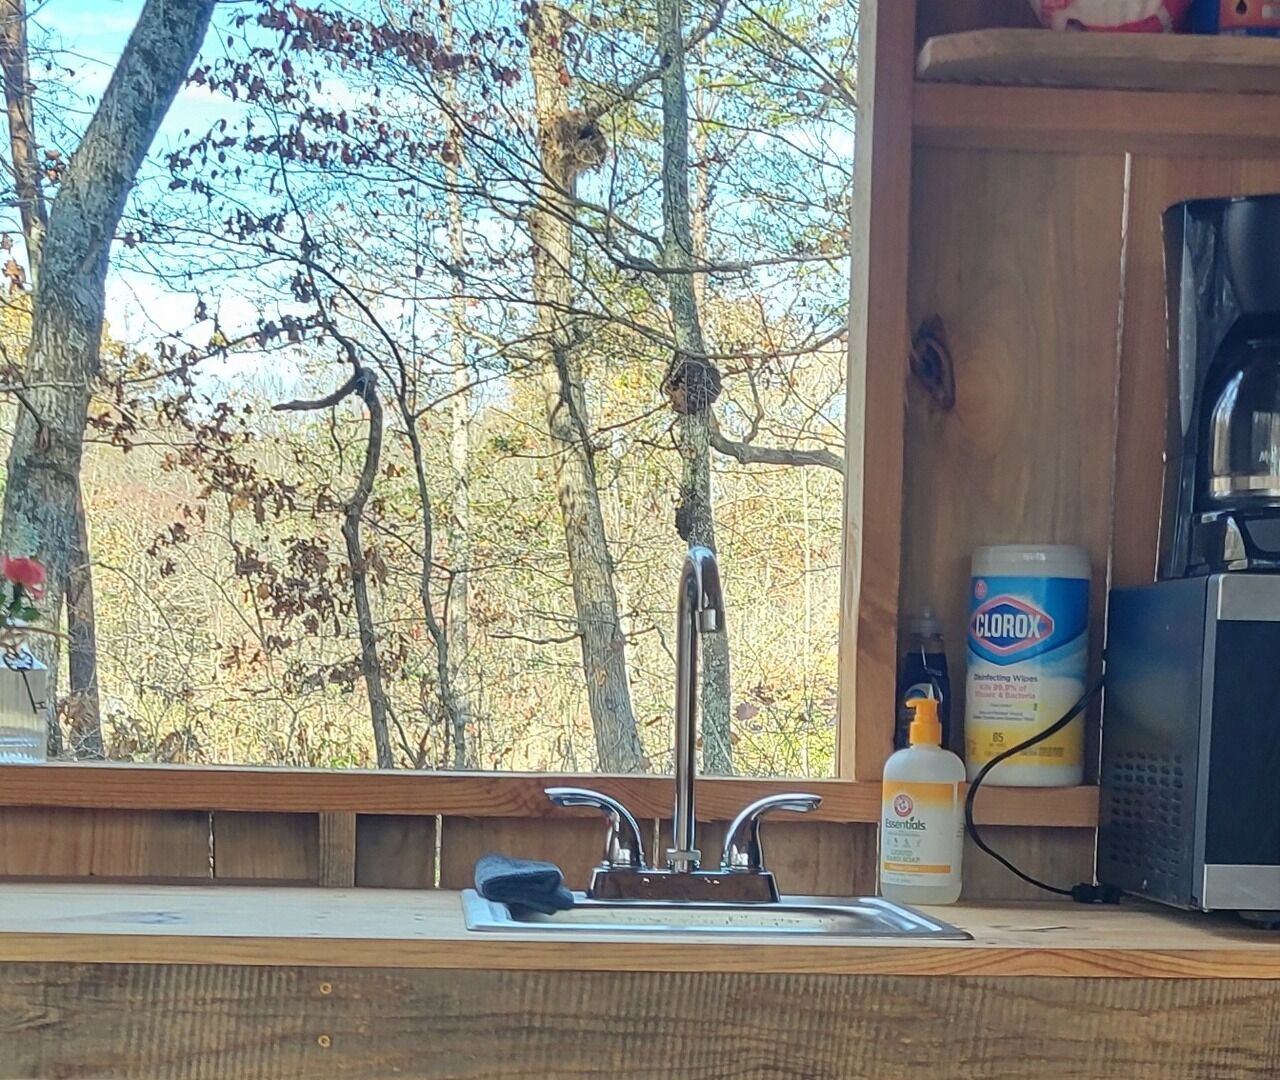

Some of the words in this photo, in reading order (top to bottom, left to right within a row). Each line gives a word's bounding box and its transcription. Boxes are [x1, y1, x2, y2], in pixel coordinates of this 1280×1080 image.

[975, 613, 1041, 639] CLOROX
[974, 673, 1011, 683] Disinfecting
[1013, 674, 1038, 683] Wipes
[1005, 692, 1036, 700] Bacteria
[885, 817, 927, 831] Essentials
